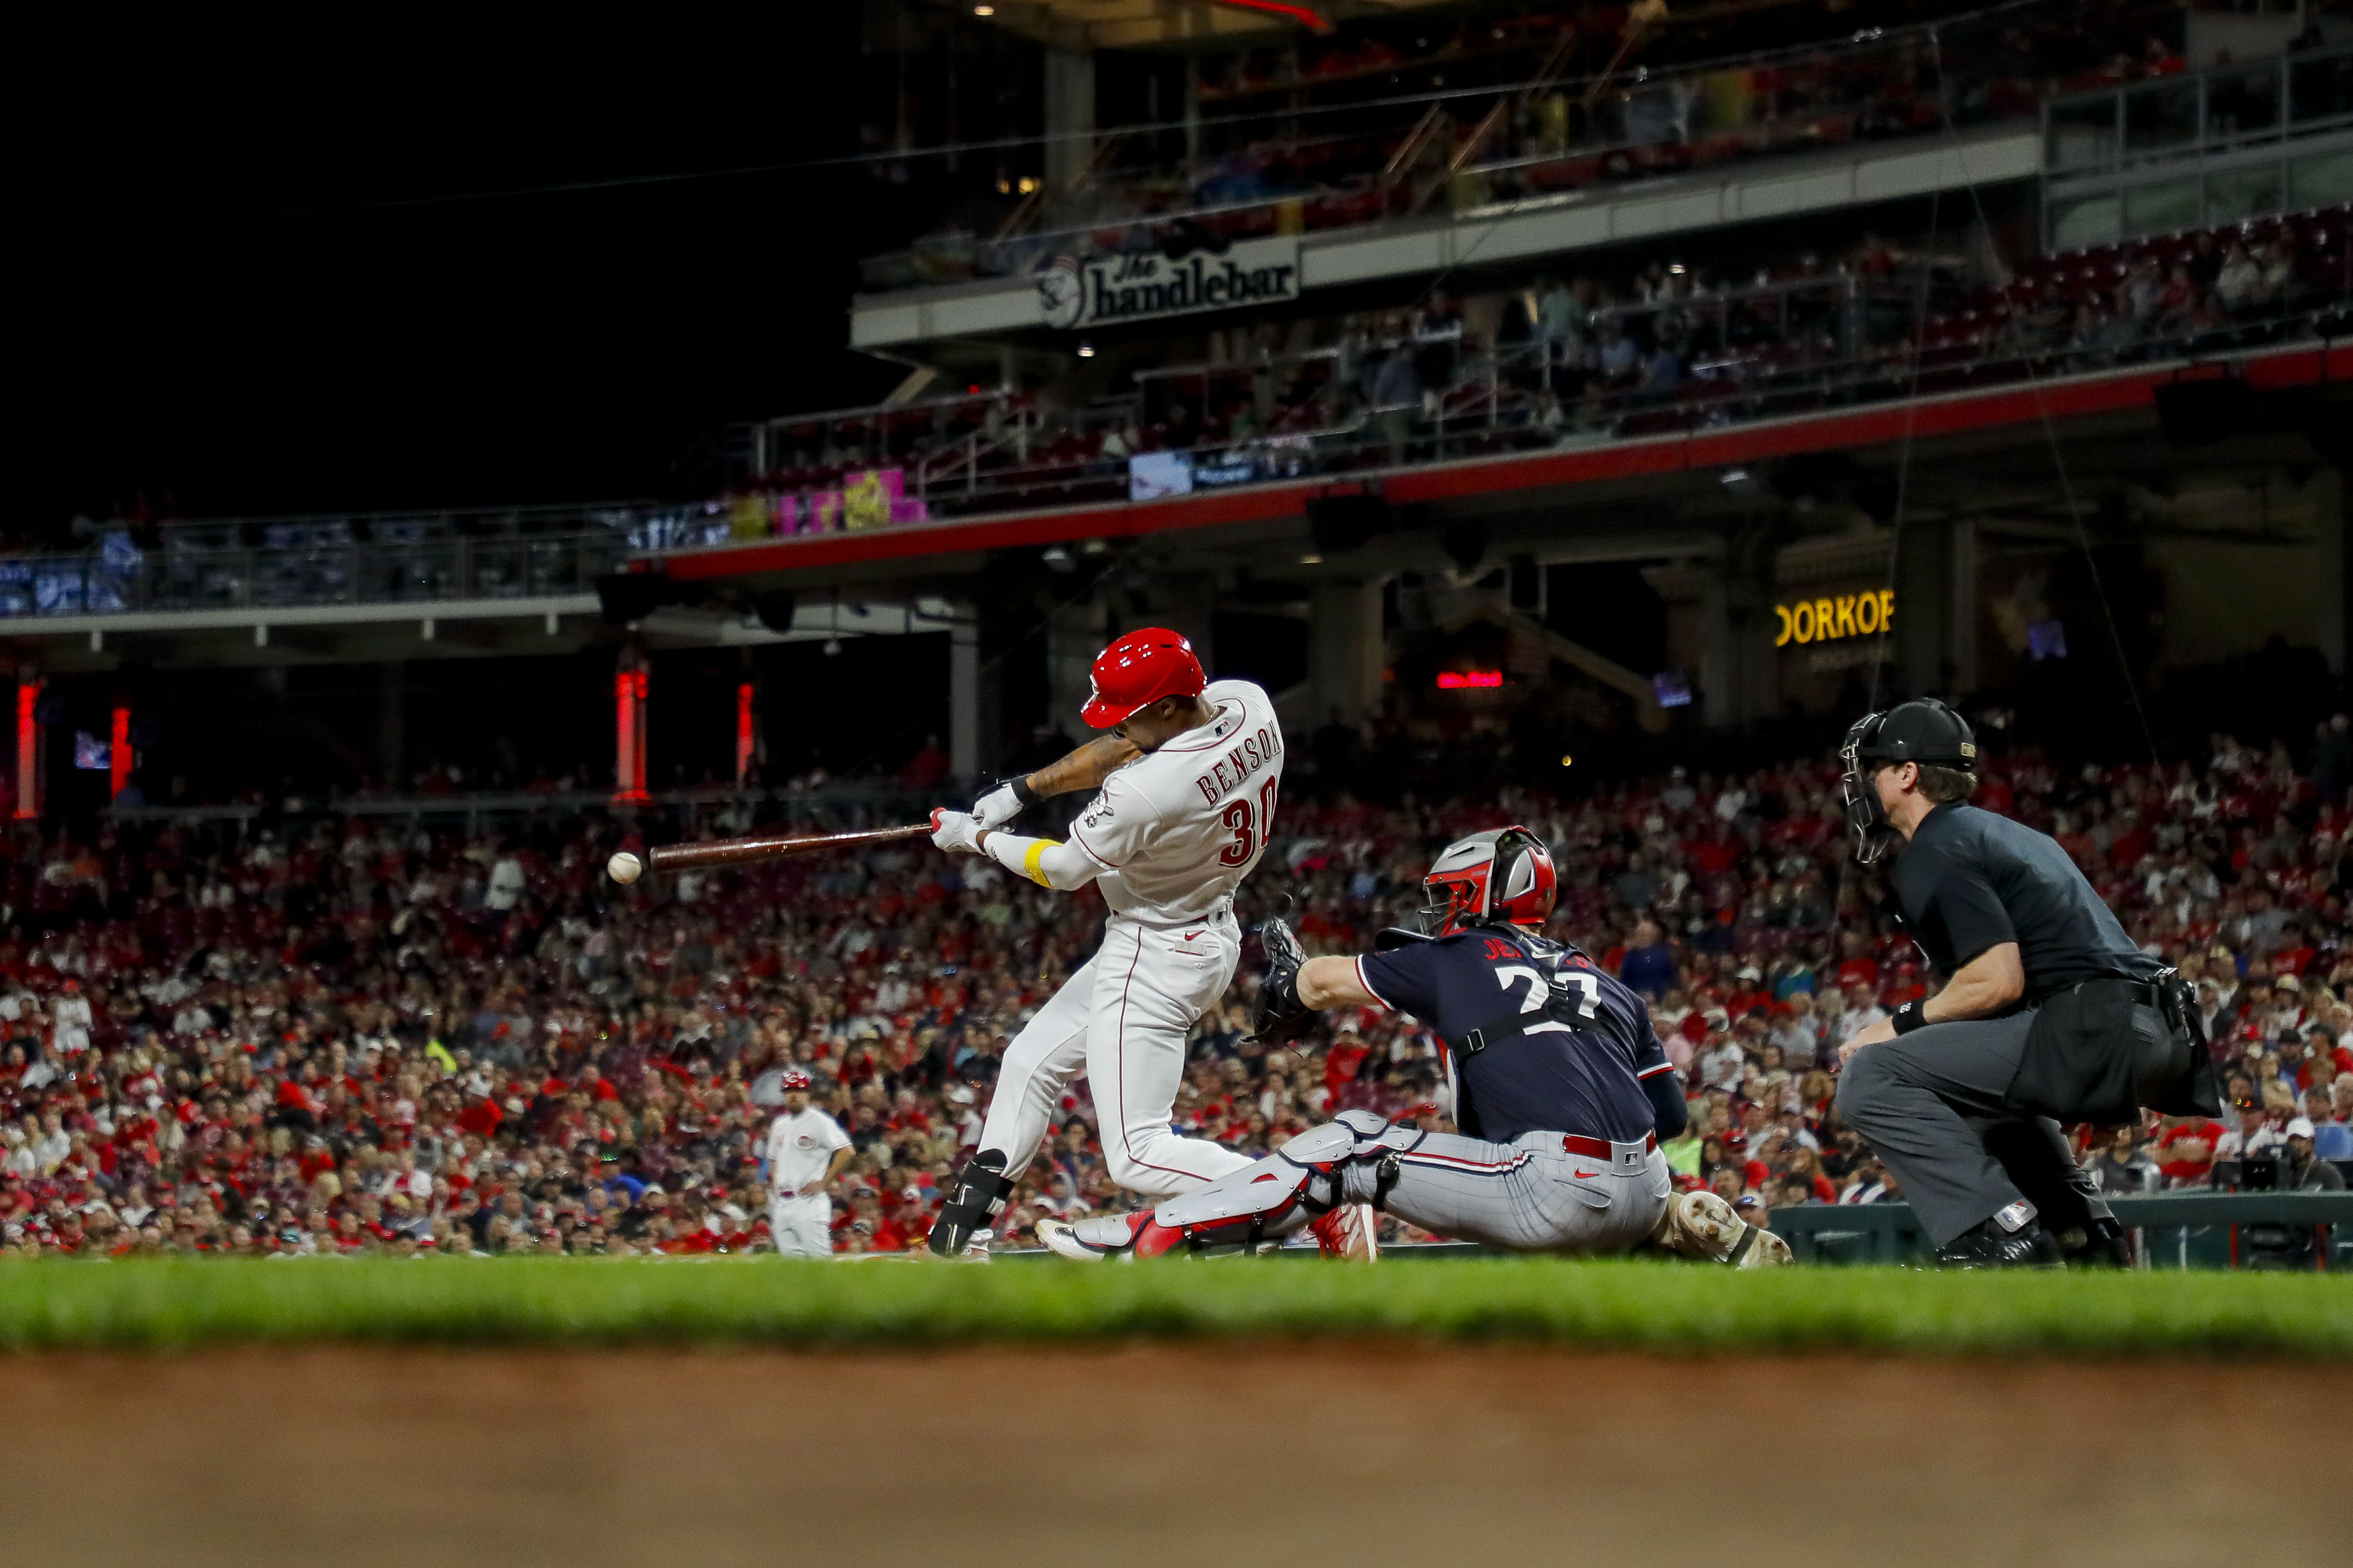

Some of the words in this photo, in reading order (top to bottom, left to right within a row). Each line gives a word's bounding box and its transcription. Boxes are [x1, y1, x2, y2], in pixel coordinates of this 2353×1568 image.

[1088, 258, 1292, 319] handlebar
[1115, 257, 1158, 283] The
[1218, 774, 1277, 868] 30
[1495, 966, 1602, 1036] 27
